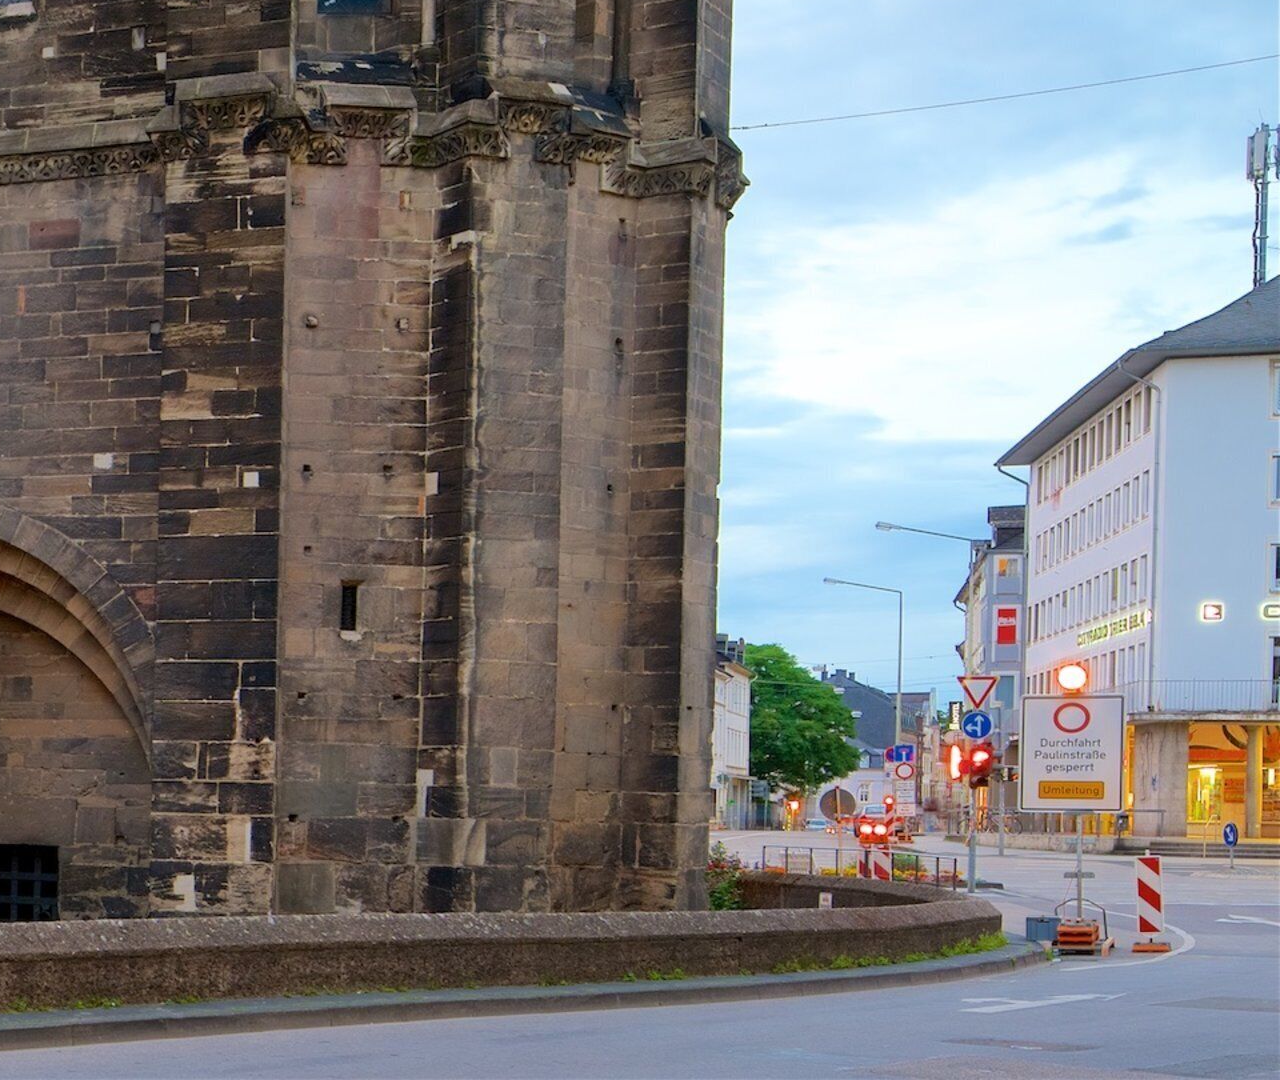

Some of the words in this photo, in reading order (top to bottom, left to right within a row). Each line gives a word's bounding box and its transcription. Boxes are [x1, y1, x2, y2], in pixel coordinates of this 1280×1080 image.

[1040, 738, 1101, 748] Durchfahrt
[1034, 750, 1106, 760] Paulinstraße
[1045, 764, 1094, 773] gesperrt
[1043, 785, 1100, 796] Umleitung
